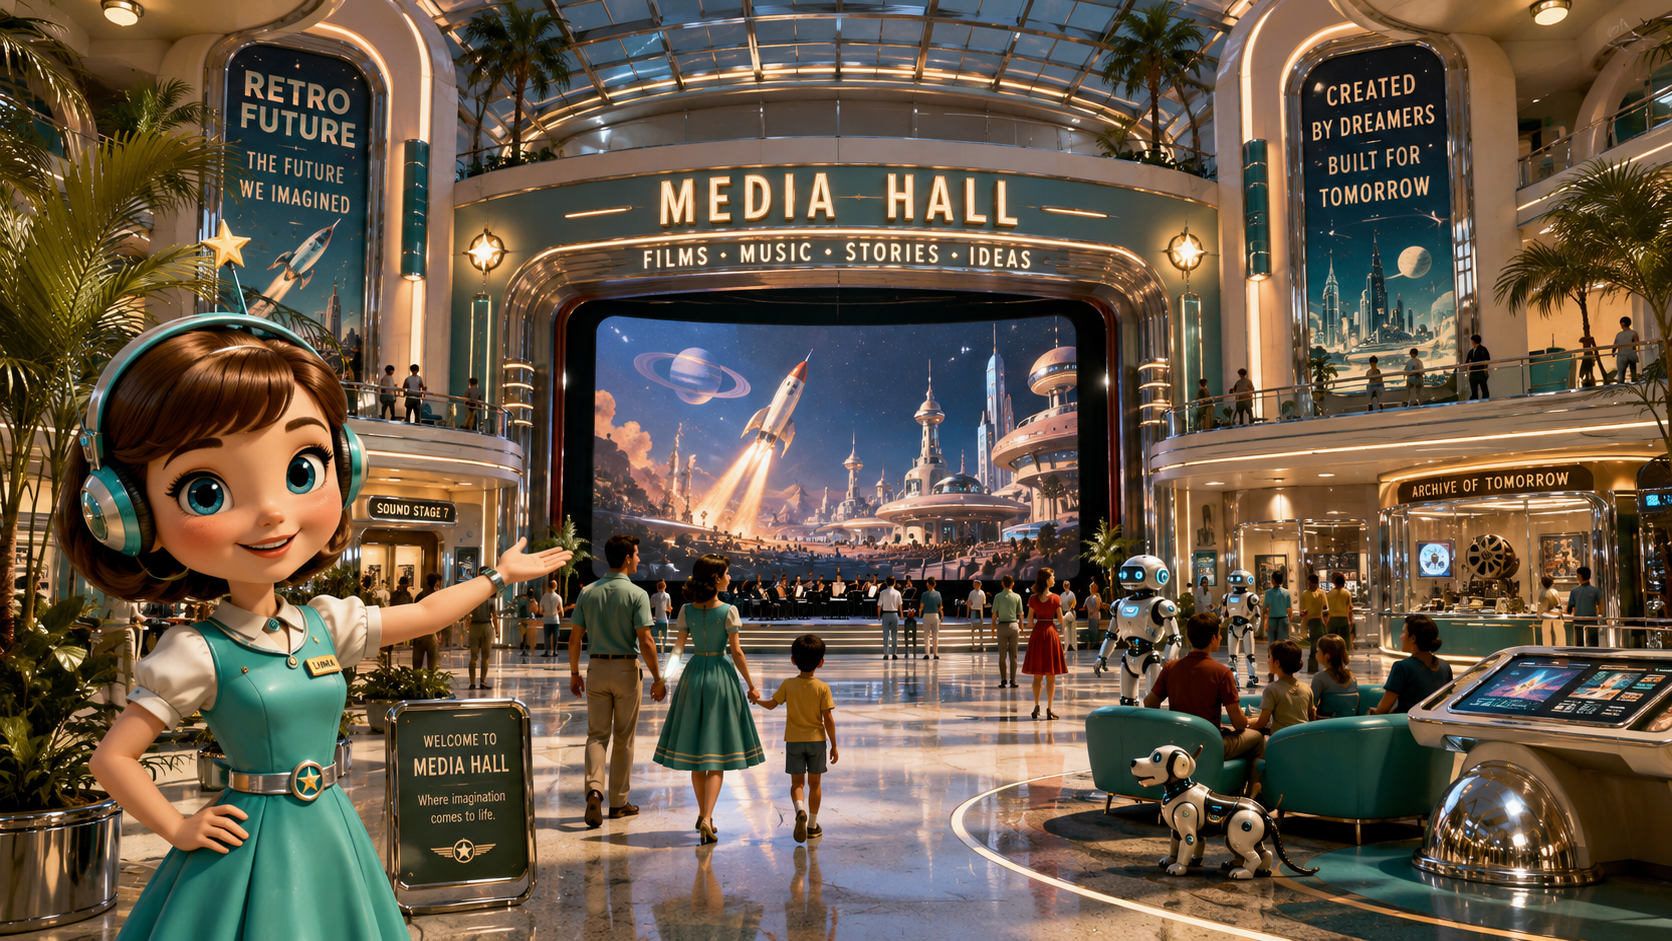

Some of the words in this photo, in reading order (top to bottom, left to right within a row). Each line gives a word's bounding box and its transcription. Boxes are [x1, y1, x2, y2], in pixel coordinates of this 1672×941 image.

[244, 70, 350, 115] RETRO
[1326, 73, 1416, 106] CREATED
[240, 101, 356, 148] FUTURE
[1312, 119, 1333, 141] BY
[1340, 104, 1435, 137] DREAMERS
[247, 151, 277, 173] THE
[284, 157, 344, 184] FUTURE
[1328, 150, 1378, 175] BUILT
[1386, 145, 1421, 168] FOR
[239, 179, 264, 200] WE
[271, 184, 350, 214] IMAGINED
[659, 172, 835, 227] MEDIA
[886, 172, 1019, 227] HALL
[1319, 175, 1430, 208] TOMORROW
[643, 246, 709, 270] FILMS
[740, 242, 812, 263] MUSIC
[845, 242, 939, 265] STORIES
[969, 246, 1032, 270] IDEAS
[1412, 480, 1457, 498] ARCHIVE
[1463, 478, 1479, 493] OF
[1485, 471, 1570, 491] TOMORROW
[377, 502, 410, 516] SOUND
[413, 505, 441, 518] STAGE
[443, 507, 449, 519] 7
[423, 733, 479, 748] WELCOME
[482, 732, 497, 746] TO
[413, 755, 465, 777] MEDIA
[470, 754, 510, 774] HALL
[418, 793, 449, 806] Where
[452, 790, 506, 806] imagination
[431, 811, 463, 824] comes
[465, 810, 475, 822] to
[478, 808, 496, 821] life.
